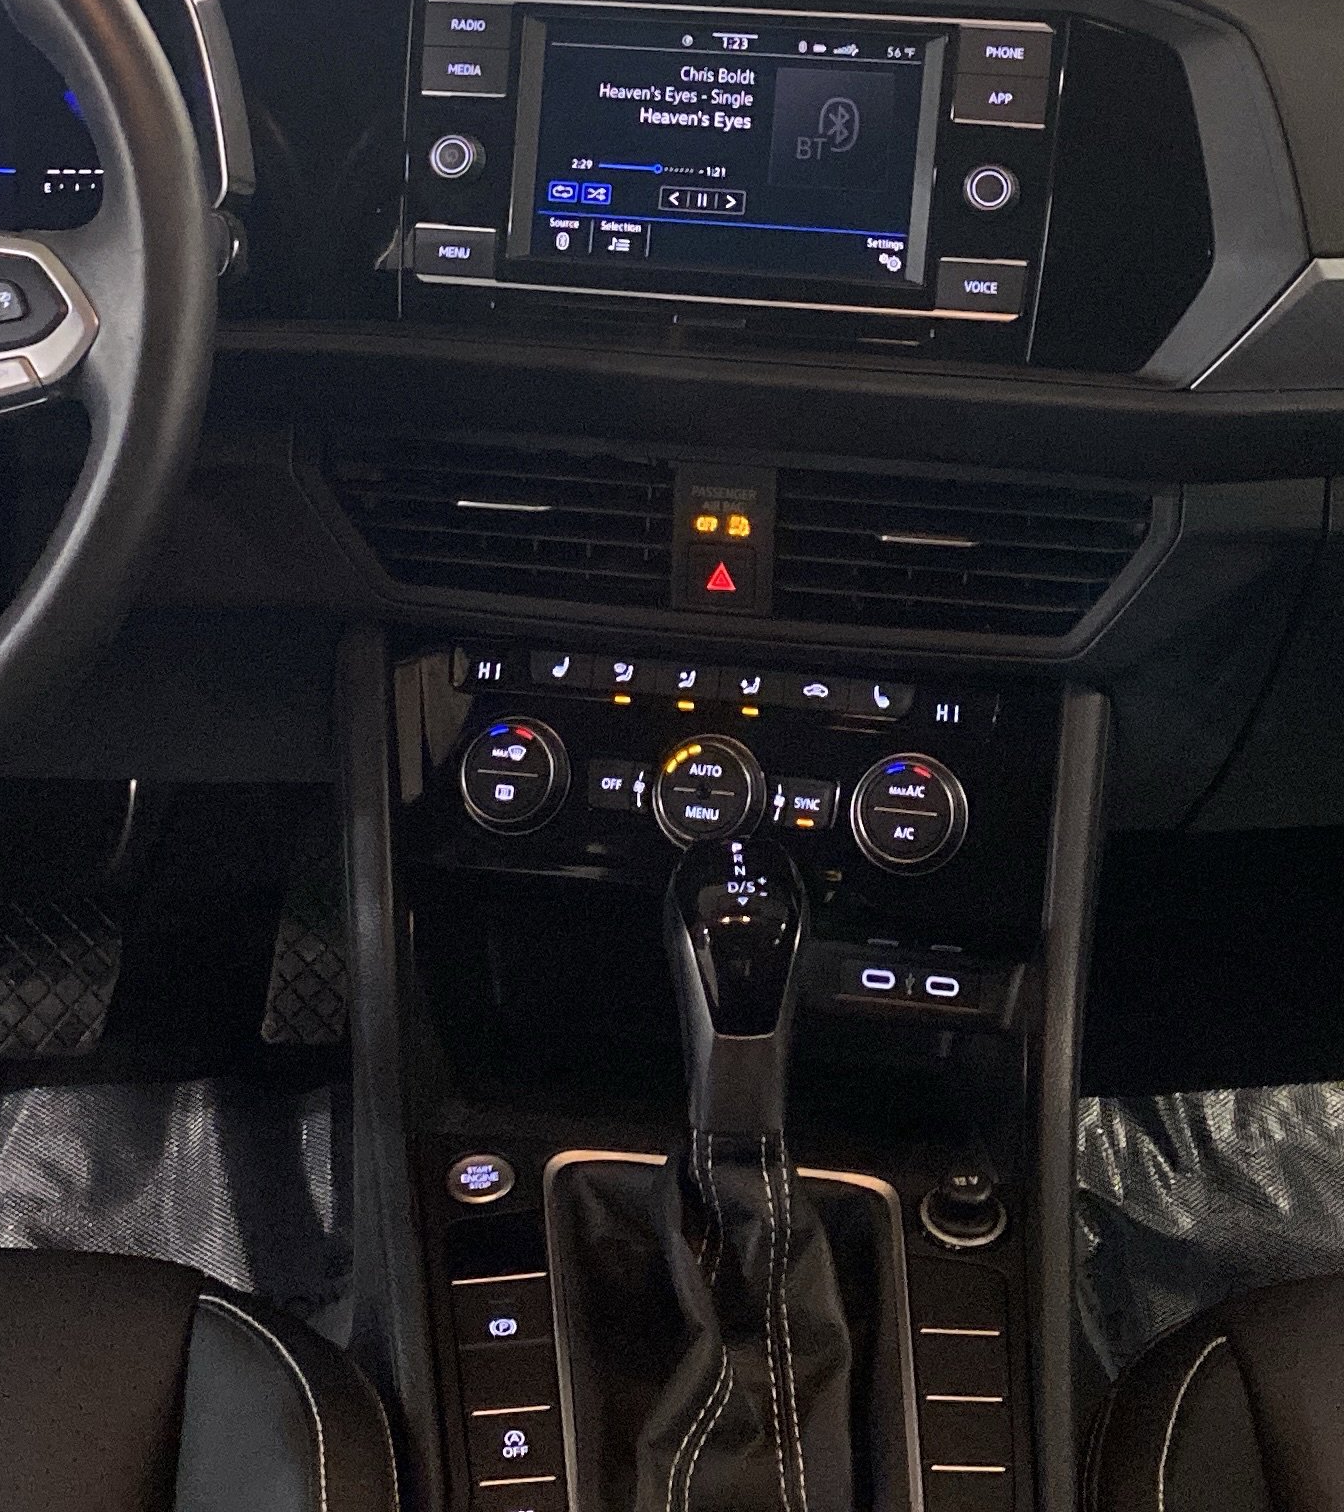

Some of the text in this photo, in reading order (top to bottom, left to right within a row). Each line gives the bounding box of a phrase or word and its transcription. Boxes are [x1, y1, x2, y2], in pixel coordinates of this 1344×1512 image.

[450, 18, 486, 32] RADIO
[721, 37, 749, 50] 1:23
[887, 46, 902, 59] 56
[985, 47, 1025, 61] PHONE
[447, 63, 482, 77] MEDIA
[680, 66, 755, 85] Chris Boldt
[599, 83, 662, 101] Heaven's
[665, 86, 698, 106] Eyes
[711, 89, 754, 108] Single
[988, 92, 1013, 106] APP
[639, 107, 752, 132] Heaven's Eyes
[796, 136, 826, 160] BT
[571, 158, 594, 170] 2:29
[44, 183, 52, 194] E
[549, 217, 579, 229] Source
[600, 221, 642, 233] Selection
[867, 237, 904, 251] Settings
[438, 246, 470, 259] MENU
[965, 280, 998, 295] VOICE
[689, 763, 722, 778] AUTO
[601, 778, 623, 790] OFF
[794, 797, 820, 811] SYNC
[685, 806, 720, 821] MENU
[893, 826, 914, 841] A/C
[734, 865, 746, 876] N
[727, 881, 756, 894] D/S
[461, 1171, 499, 1183] ENGINE
[502, 1445, 529, 1459] OFF
